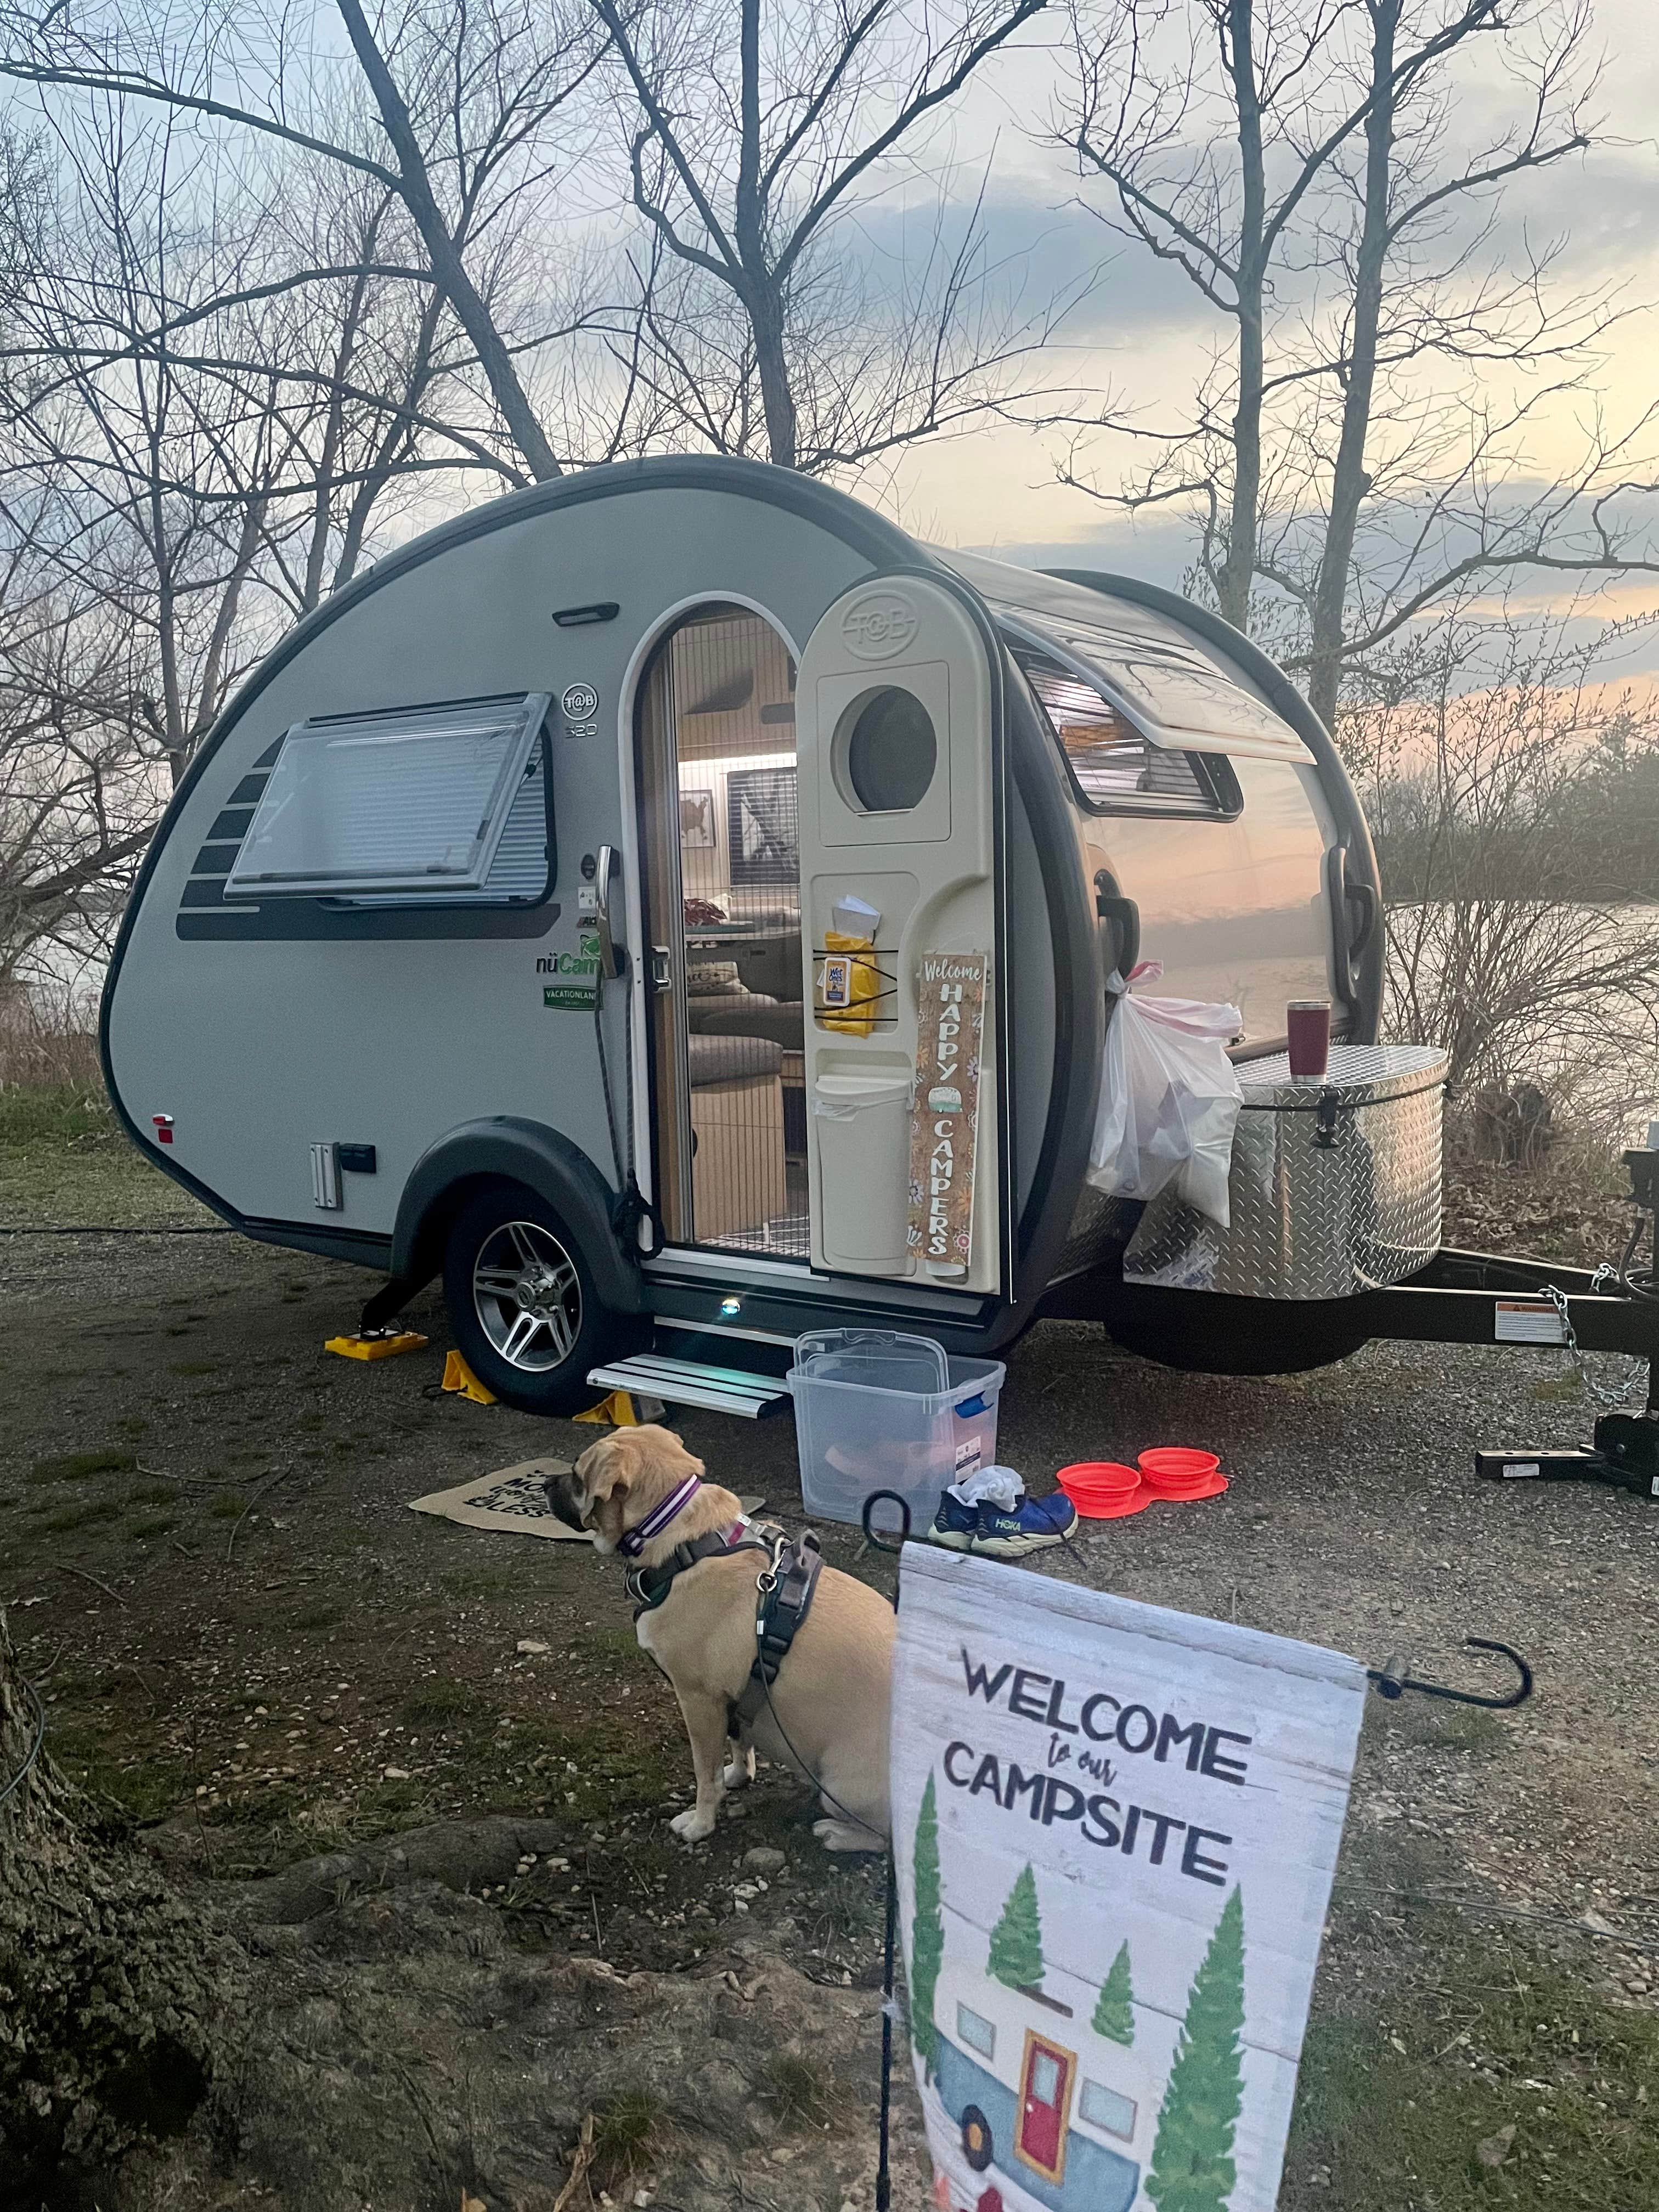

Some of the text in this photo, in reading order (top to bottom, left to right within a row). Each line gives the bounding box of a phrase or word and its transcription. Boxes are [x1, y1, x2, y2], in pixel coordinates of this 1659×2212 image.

[565, 692, 594, 712] T@B
[536, 952, 601, 975] nüCam
[924, 959, 982, 981] Welcome
[546, 990, 595, 1000] VACATIONLAN
[936, 983, 963, 1081] HAPPY
[928, 1120, 954, 1255] CAMPERS
[487, 1501, 551, 1517] LESS
[995, 1518, 1021, 1531] HOKA
[961, 1645, 1252, 1786] WELCOME
[1048, 1732, 1117, 1787] to our
[943, 1741, 1233, 1887] CAMPSITE
